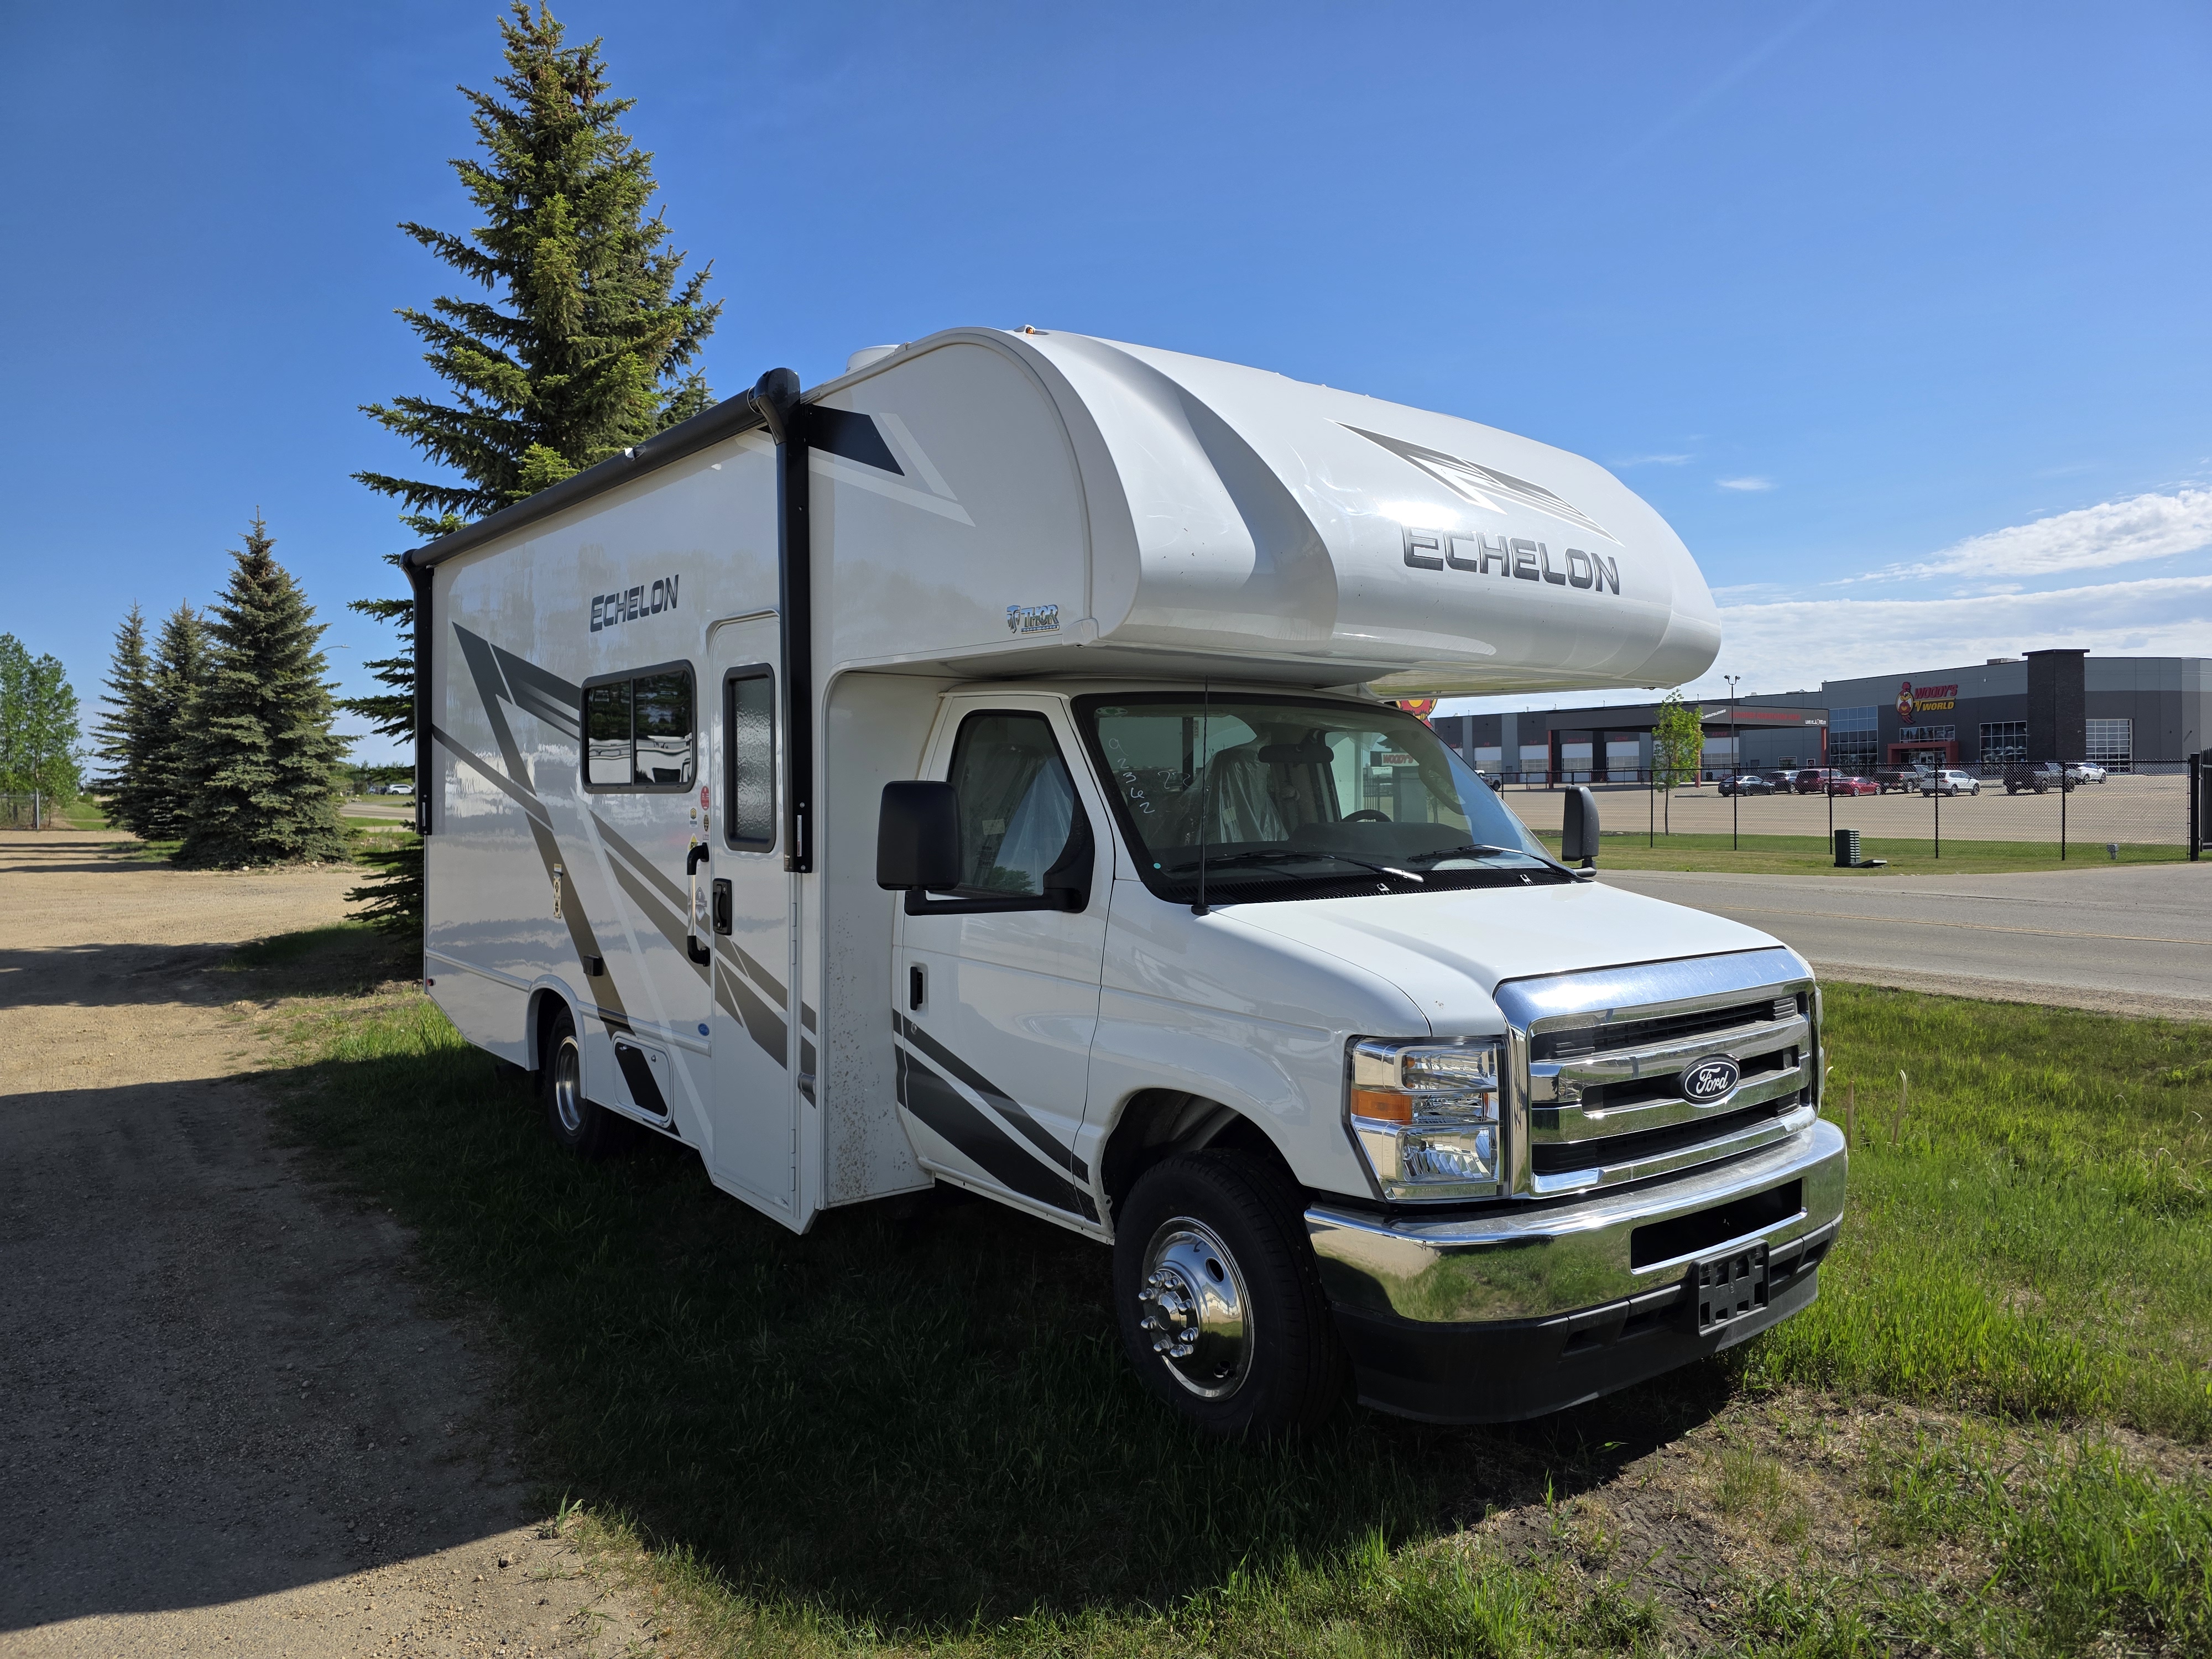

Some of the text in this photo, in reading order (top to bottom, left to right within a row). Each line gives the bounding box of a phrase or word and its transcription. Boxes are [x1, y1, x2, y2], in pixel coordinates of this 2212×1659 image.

[1401, 523, 1620, 596] ECHELON
[590, 574, 679, 633] ECHELON
[1021, 604, 1059, 627] THOR
[1914, 684, 1958, 700] WOODY'S
[1922, 701, 1954, 711] WORLD
[1696, 1067, 1729, 1094] Ford
